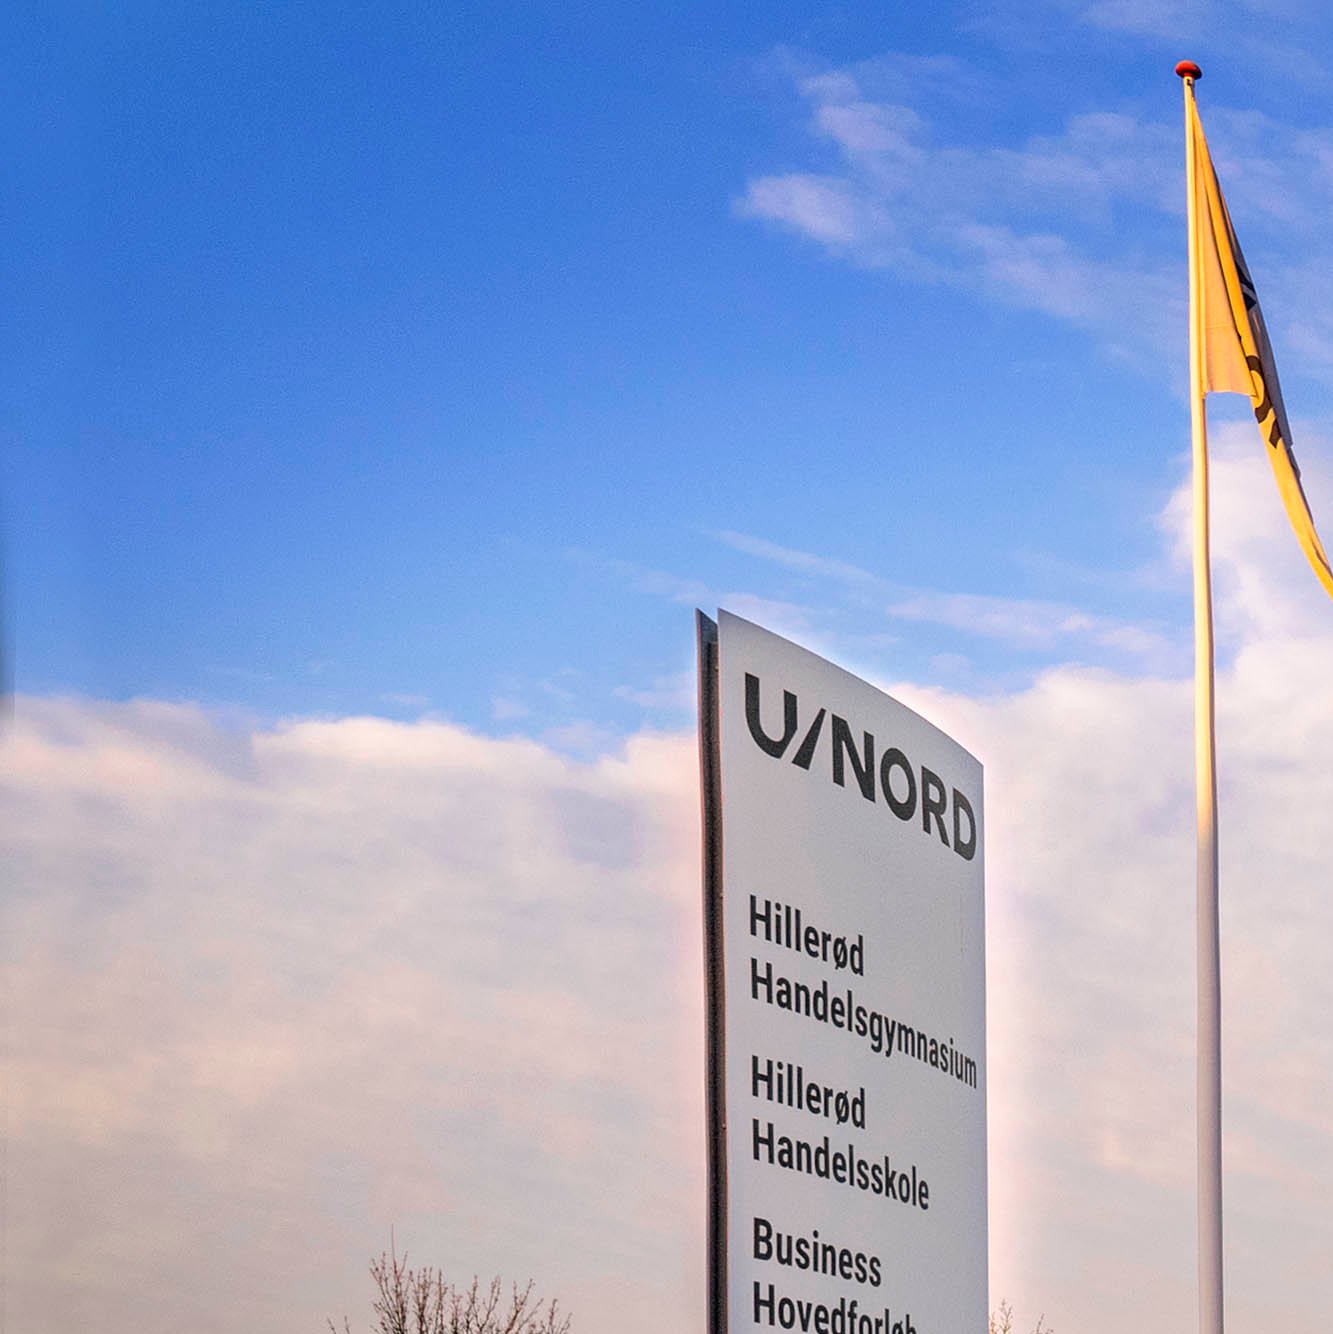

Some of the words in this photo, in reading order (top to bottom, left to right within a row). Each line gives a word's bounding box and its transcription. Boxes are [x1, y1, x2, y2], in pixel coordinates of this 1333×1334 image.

[745, 672, 977, 861] U/NORD
[750, 894, 864, 977] Hillerød
[751, 957, 977, 1089] Handelsgymnasium
[752, 1055, 866, 1129] Hillerød
[753, 1118, 929, 1210] Handelsskole
[754, 1217, 881, 1287] Business
